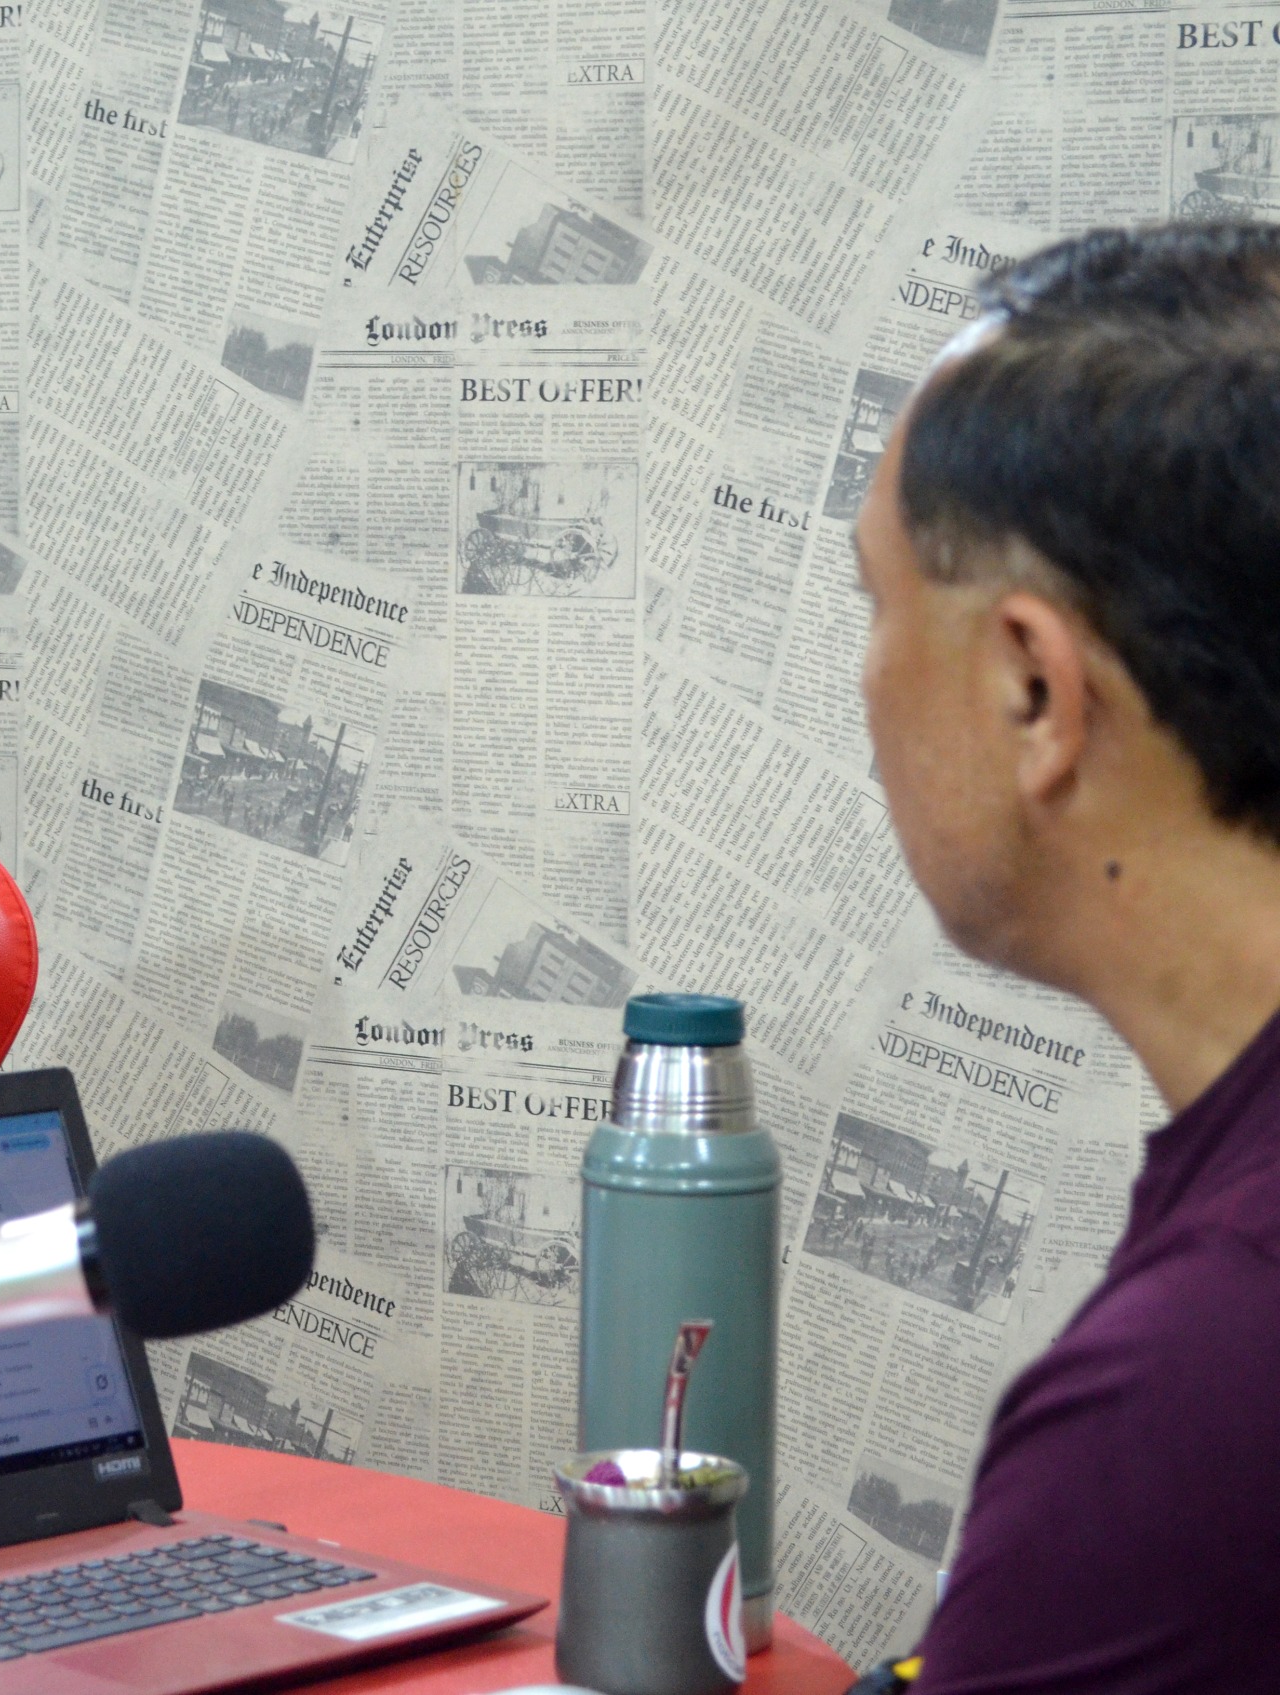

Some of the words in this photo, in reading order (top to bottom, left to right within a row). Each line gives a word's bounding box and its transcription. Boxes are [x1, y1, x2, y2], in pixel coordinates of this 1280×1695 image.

[1177, 20, 1263, 49] BEST
[85, 99, 118, 125] the
[122, 107, 168, 138] first
[345, 148, 422, 272] Enterprise
[399, 140, 482, 286] RESOURCES
[365, 314, 458, 346] London
[470, 312, 548, 344] Press
[460, 377, 532, 402] BEST
[713, 484, 753, 513] the
[758, 495, 812, 531] first
[267, 560, 409, 624] Independence
[228, 601, 391, 668] NDEPENDENCE
[81, 778, 115, 805] the
[118, 791, 165, 824] first
[554, 792, 621, 812] EXTRA
[336, 857, 413, 974] Enterprise
[388, 855, 472, 991] RESOURCES
[355, 1015, 445, 1046] London
[458, 1021, 535, 1053] Press
[919, 990, 1086, 1067] Independence
[592, 1074, 612, 1083] PRIC
[872, 1031, 1063, 1114] NDEPENDENCE
[448, 1084, 517, 1113] BEST
[306, 1269, 396, 1318] pendence
[272, 1302, 378, 1360] ENDENCE
[539, 1492, 563, 1513] EX
